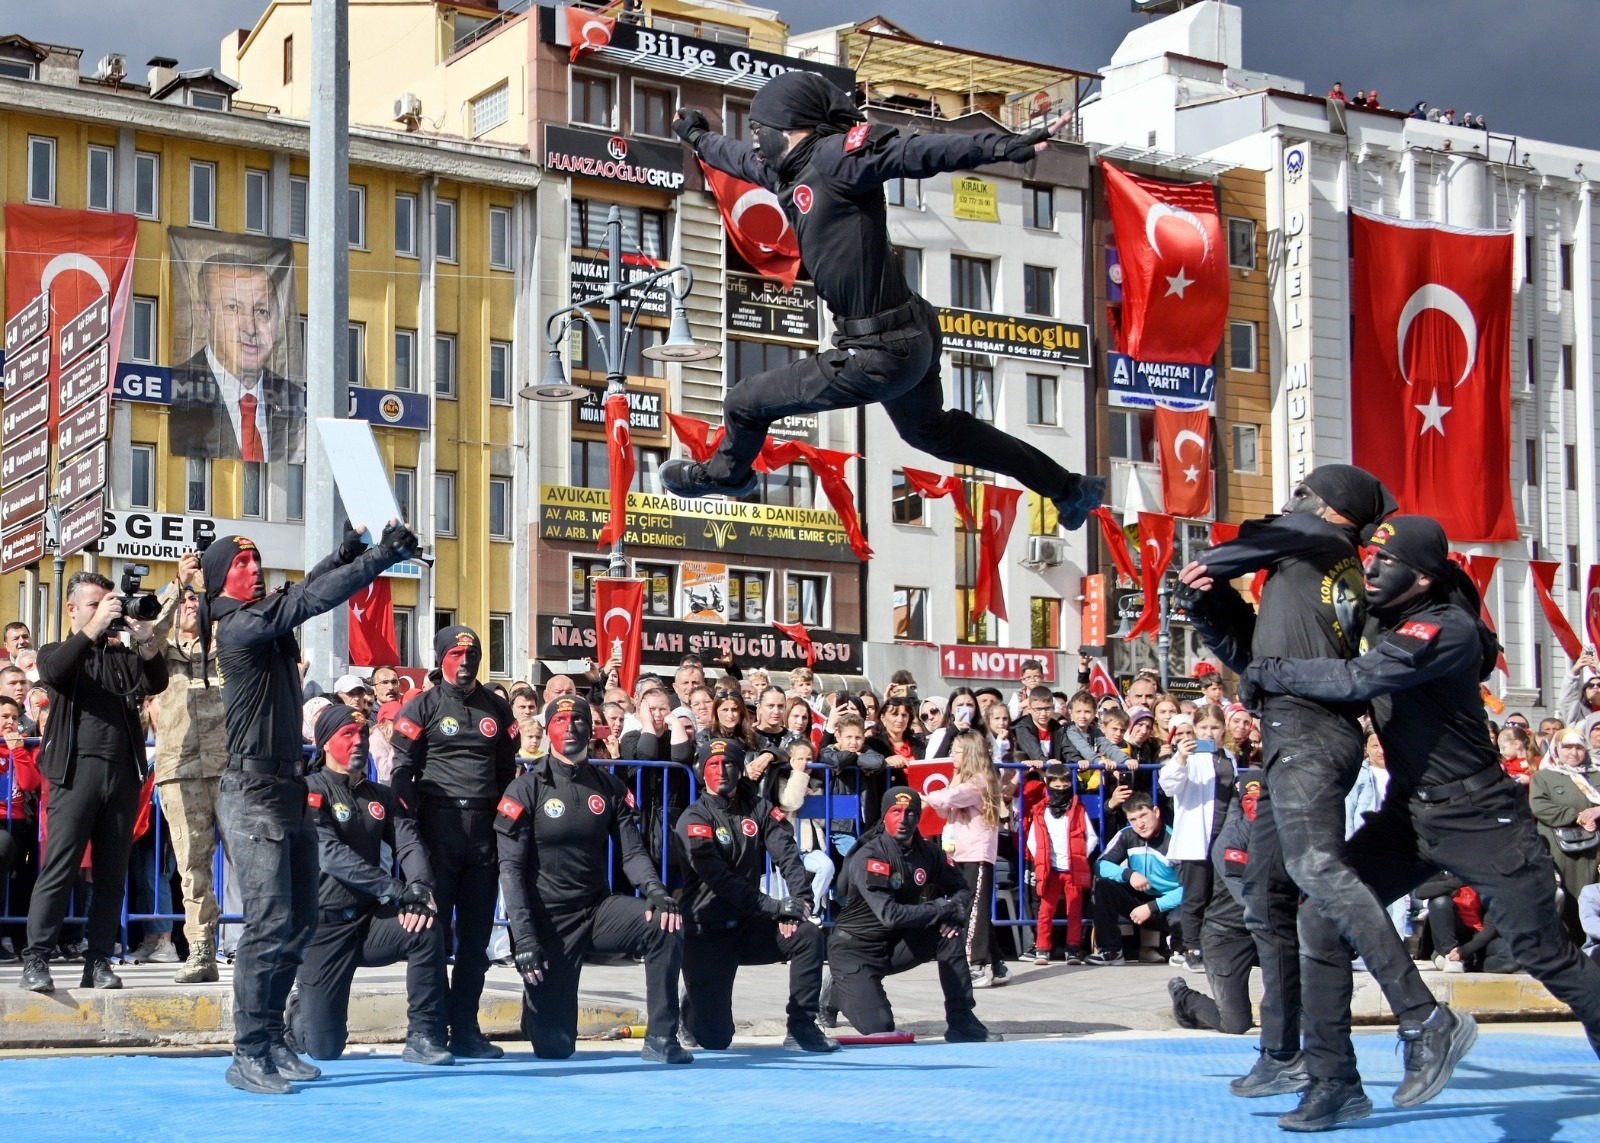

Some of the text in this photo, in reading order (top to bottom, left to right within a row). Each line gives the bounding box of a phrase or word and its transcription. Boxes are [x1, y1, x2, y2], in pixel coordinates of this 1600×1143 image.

[636, 30, 716, 65] Bilge
[1286, 209, 1305, 330] OTEL
[938, 308, 1080, 350] üderrisoglu
[965, 339, 973, 348] &
[1014, 346, 1028, 355] 542
[1042, 349, 1051, 358] 37
[1052, 351, 1062, 359] 37
[1113, 358, 1130, 378] A
[1137, 362, 1190, 379] ANAHTAR
[1148, 375, 1180, 391] PARTİ
[629, 412, 660, 428] ŞENLİK
[547, 487, 609, 506] AVUKATL
[627, 494, 638, 507] &
[641, 495, 747, 518] ARABULUCULUK
[752, 506, 762, 519] &
[545, 508, 562, 520] AV.
[564, 509, 589, 522] ARB.
[638, 514, 673, 530] ÇİFTCİ
[545, 525, 562, 538] AV.
[564, 527, 589, 540] ARB.
[641, 531, 686, 547] DEMİRCİ
[749, 525, 764, 537] AV.
[767, 526, 796, 542] ŞAMİL
[798, 530, 825, 543] EMRE
[1089, 577, 1098, 587] 1.
[552, 626, 684, 652] NASLAH
[690, 630, 776, 657] SÜRÜCÜ
[944, 650, 965, 670] 1.
[1170, 681, 1200, 689] Kuaför
